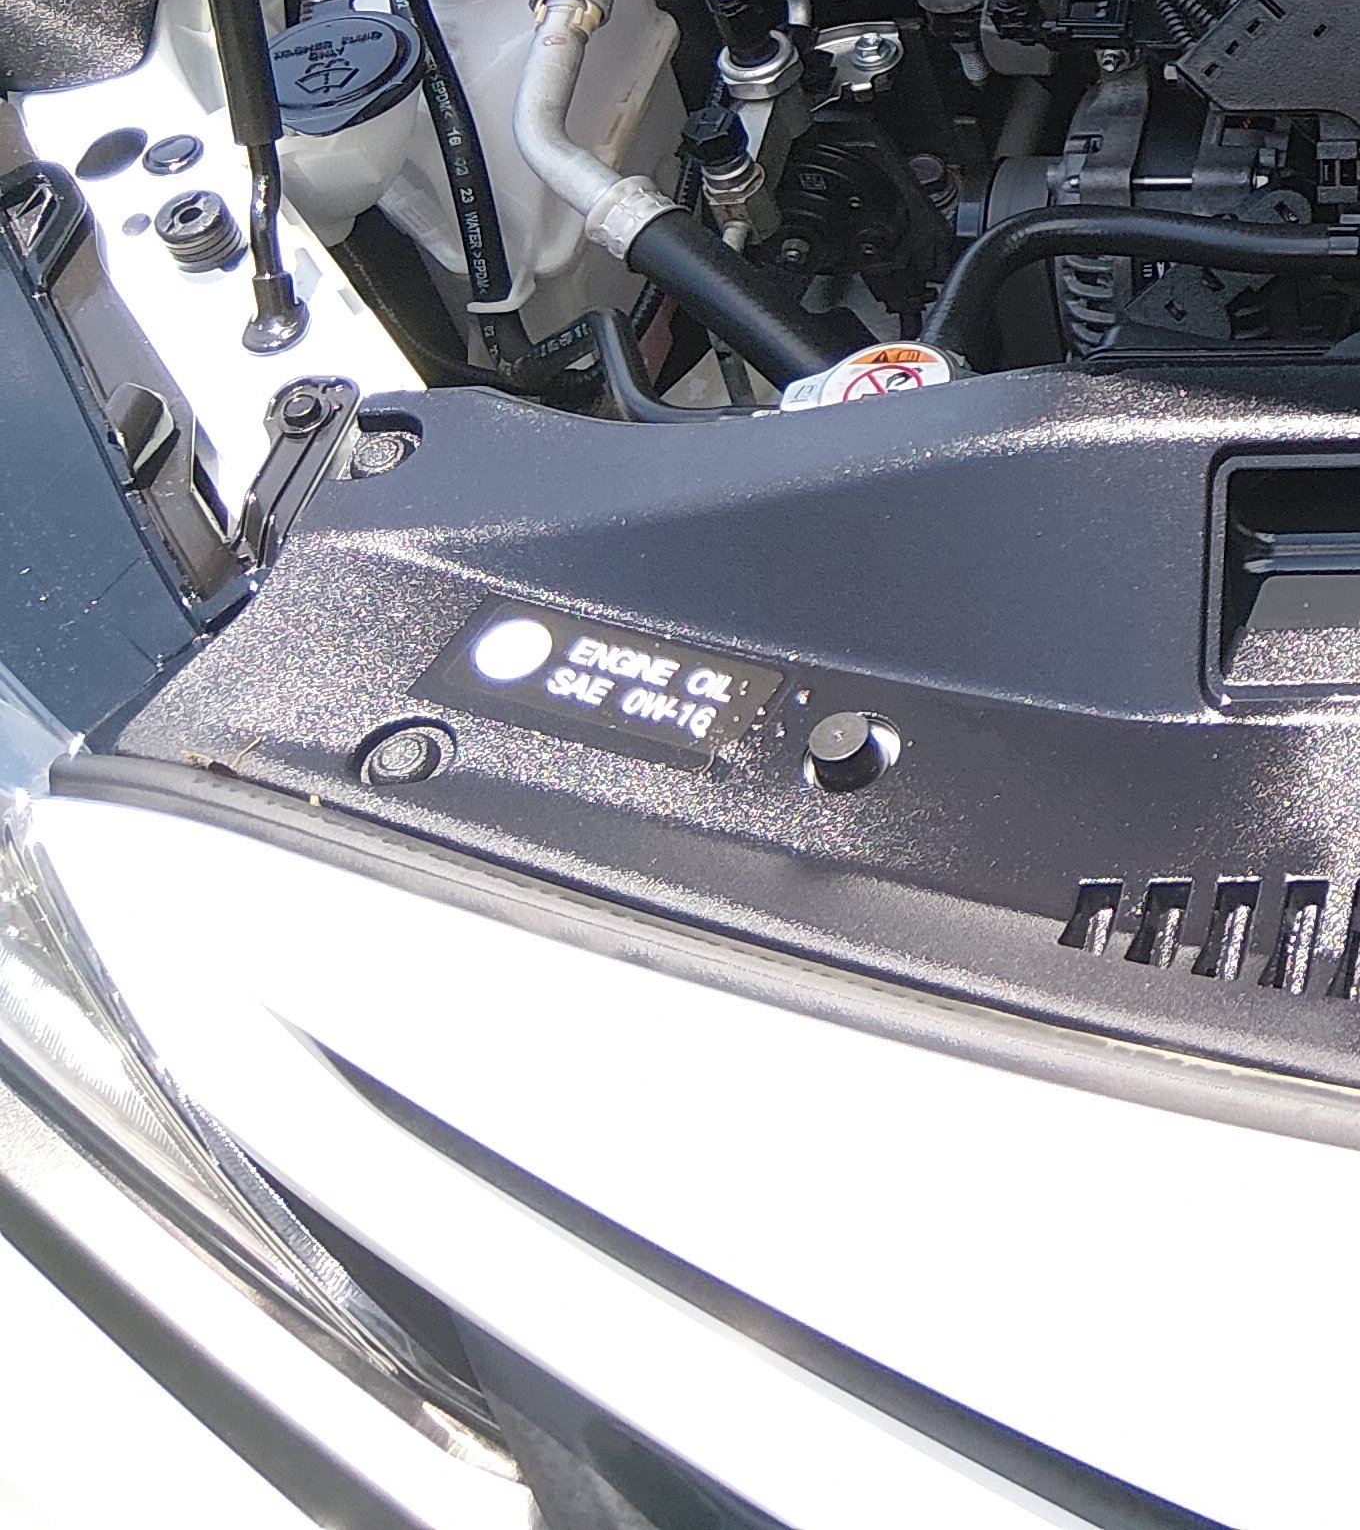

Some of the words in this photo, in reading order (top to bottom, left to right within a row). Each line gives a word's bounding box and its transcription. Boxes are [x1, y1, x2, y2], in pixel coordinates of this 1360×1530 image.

[459, 188, 475, 204] 23
[546, 668, 614, 706] SAE
[622, 688, 718, 738] 0W-16
[568, 636, 681, 687] ENGINE
[686, 667, 734, 703] OIL
